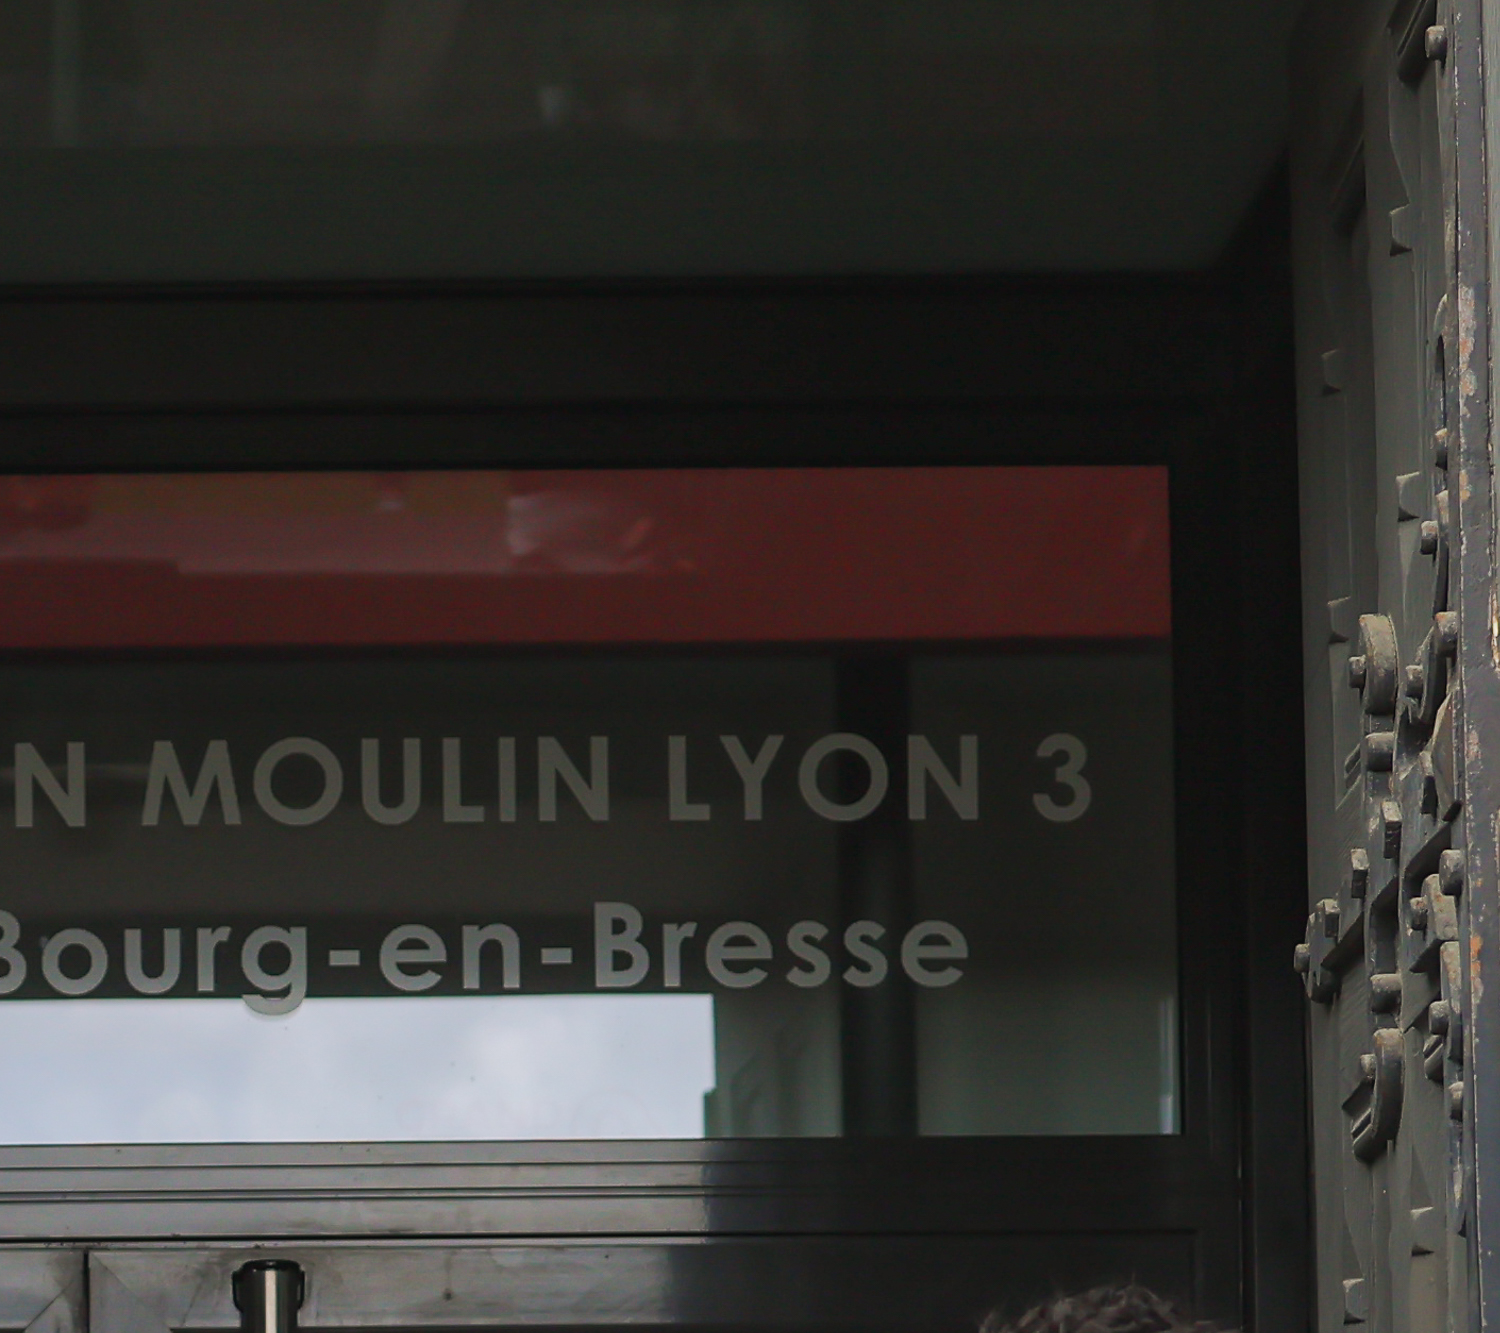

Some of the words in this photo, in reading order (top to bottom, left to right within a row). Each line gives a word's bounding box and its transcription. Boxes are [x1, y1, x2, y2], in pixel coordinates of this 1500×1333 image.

[140, 736, 610, 827] MOULIN
[667, 734, 980, 822] LYON
[1032, 733, 1092, 822] 3
